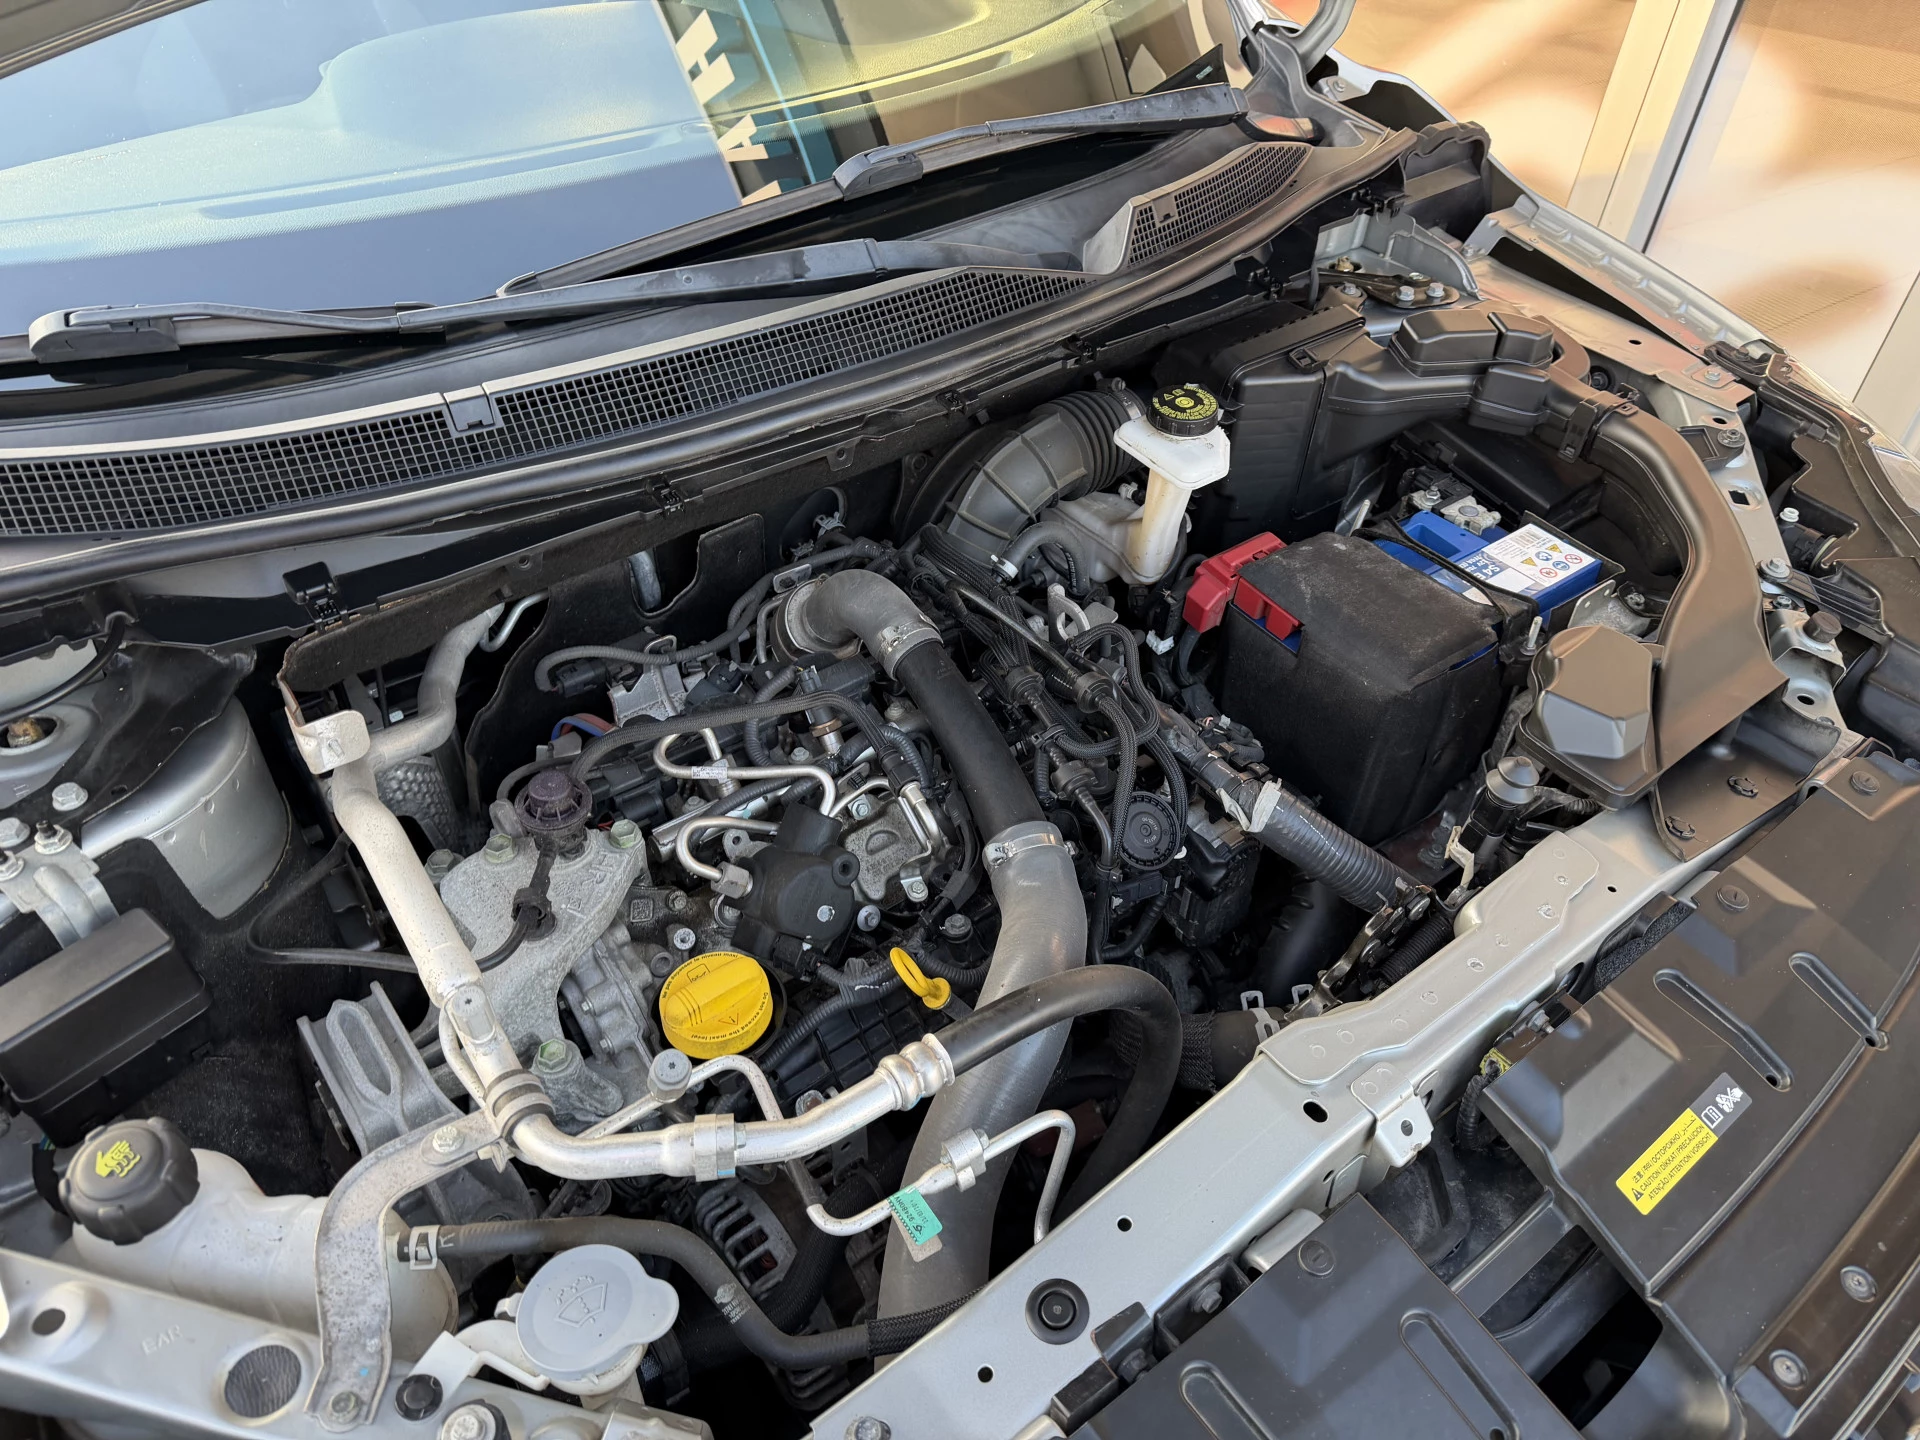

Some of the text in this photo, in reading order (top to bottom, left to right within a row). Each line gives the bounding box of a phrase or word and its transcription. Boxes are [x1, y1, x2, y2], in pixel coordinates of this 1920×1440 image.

[1482, 564, 1500, 576] S4
[1669, 1154, 1691, 1178] ATTENTION
[1690, 1132, 1712, 1154] VORSICHT
[1640, 1169, 1661, 1191] CAUTION
